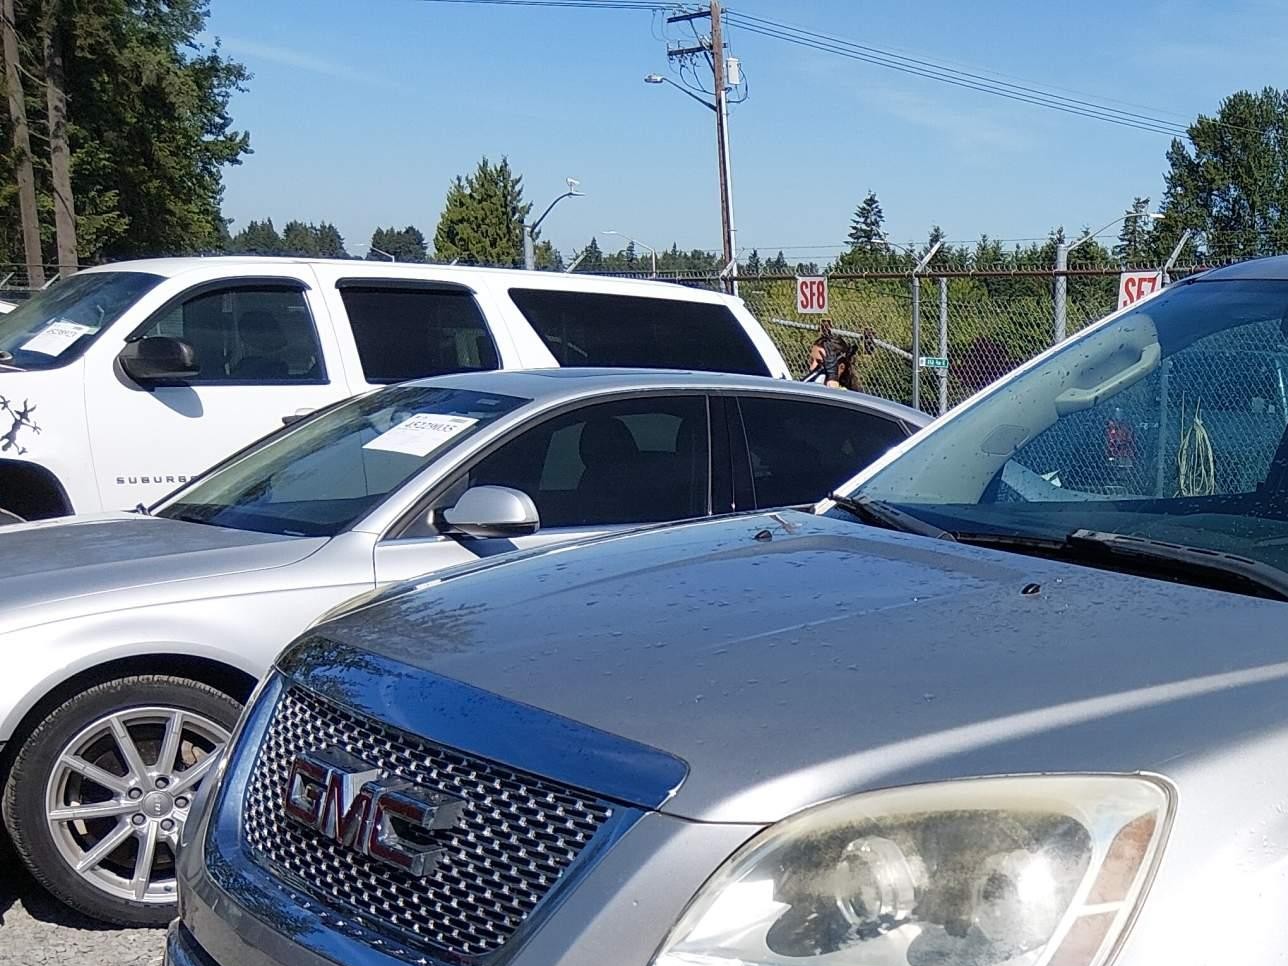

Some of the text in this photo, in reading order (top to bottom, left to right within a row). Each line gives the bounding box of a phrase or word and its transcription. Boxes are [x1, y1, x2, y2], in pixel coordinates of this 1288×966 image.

[800, 280, 825, 309] SF8
[1123, 277, 1157, 308] SF7
[284, 750, 467, 877] GMC
